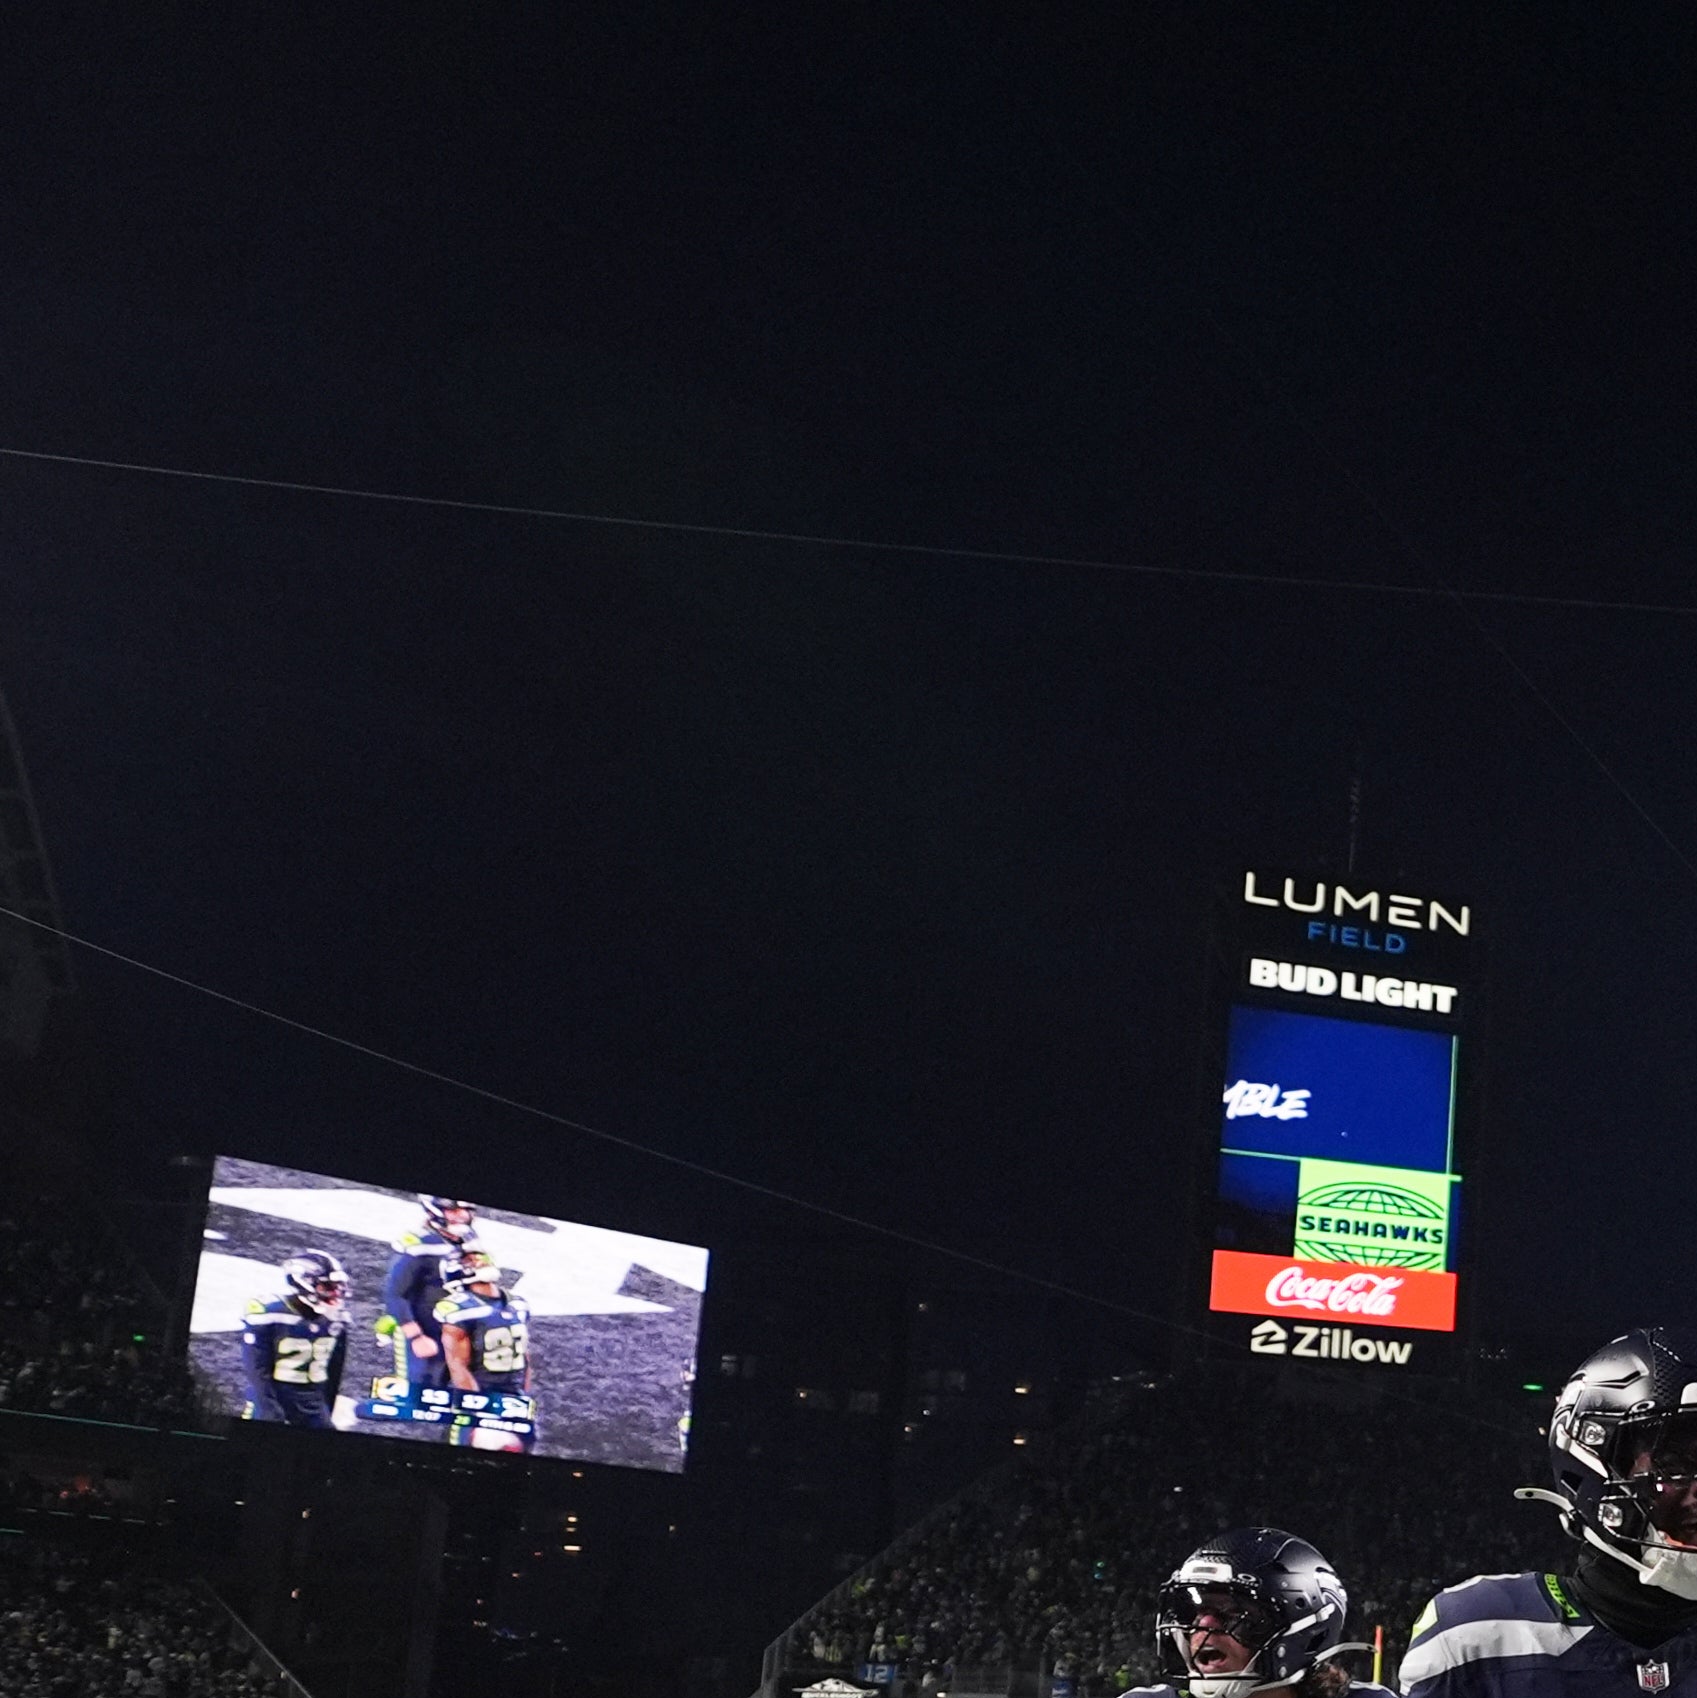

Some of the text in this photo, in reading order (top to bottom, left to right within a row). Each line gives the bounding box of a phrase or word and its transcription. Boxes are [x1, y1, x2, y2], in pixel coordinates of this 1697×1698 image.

[1244, 871, 1471, 937] LUMEN
[1307, 920, 1408, 955] FIELD
[1249, 957, 1458, 1014] BUD LIGHT
[1299, 1213, 1445, 1246] SEAHAWKS
[1264, 1266, 1404, 1317] Coca-Cola
[1291, 1326, 1413, 1365] Zillow
[864, 1664, 889, 1683] 12
